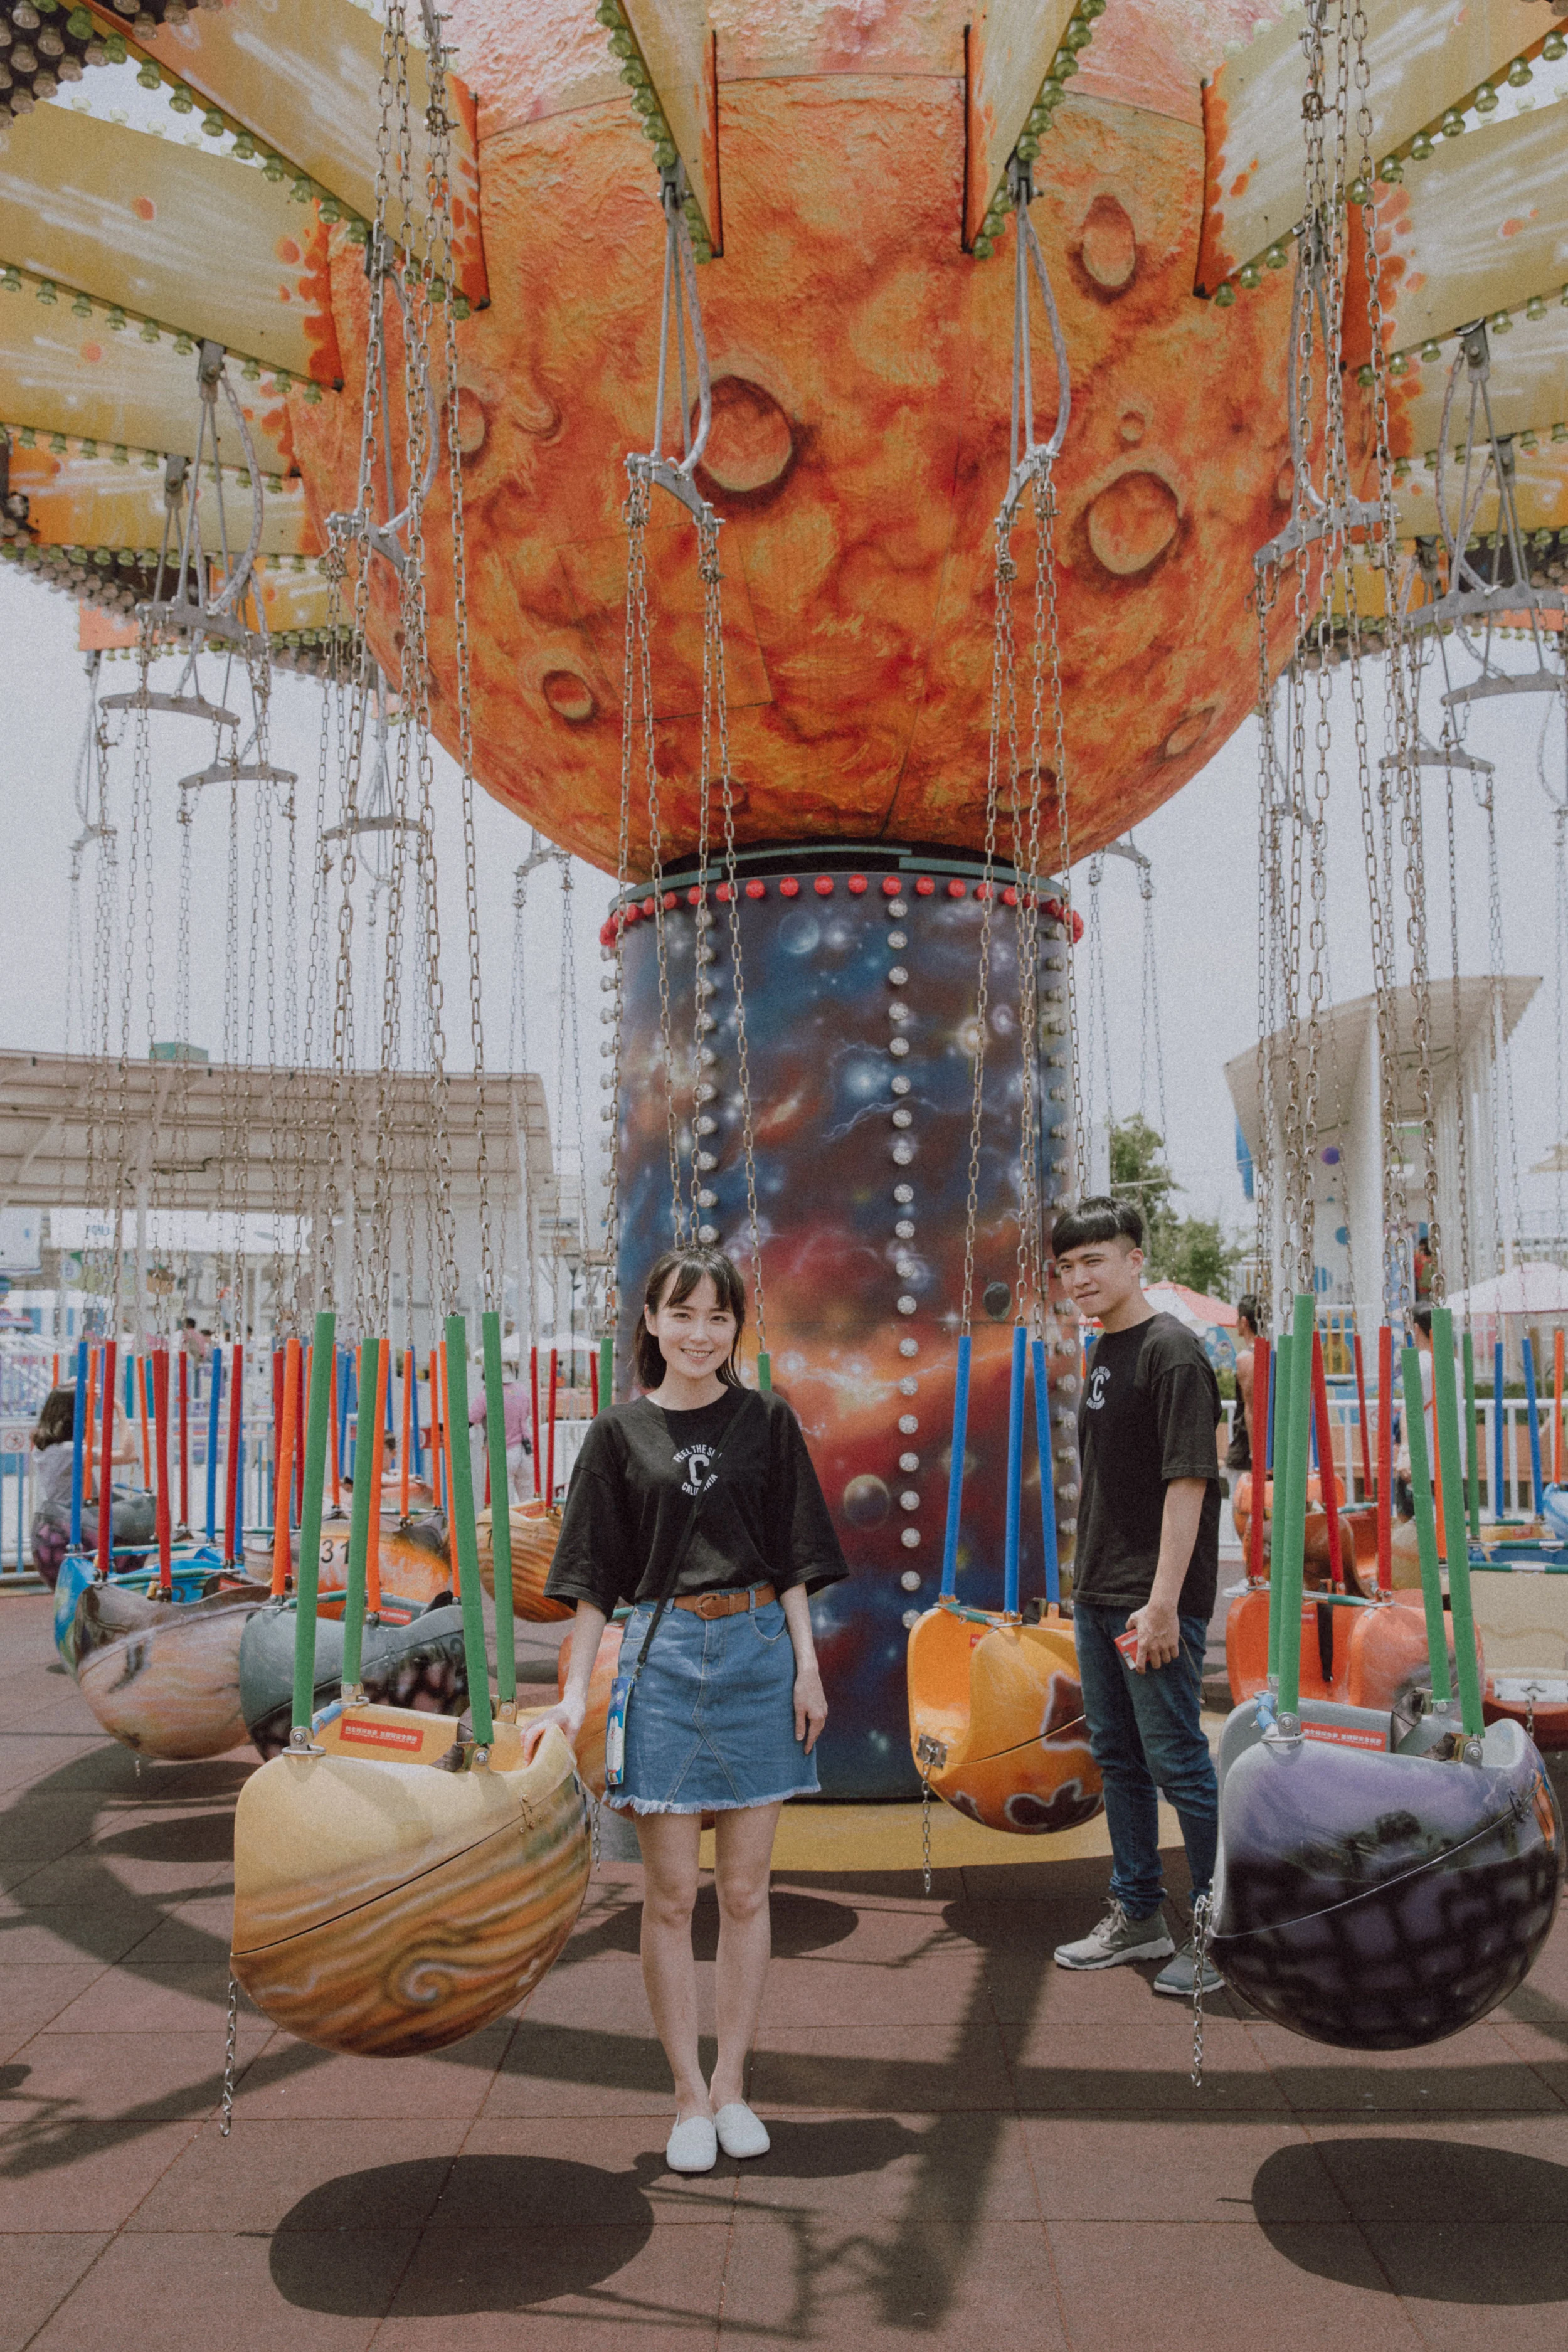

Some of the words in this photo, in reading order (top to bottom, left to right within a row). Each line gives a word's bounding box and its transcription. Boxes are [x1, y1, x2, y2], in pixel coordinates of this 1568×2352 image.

[1093, 1375, 1104, 1401] C
[672, 1448, 692, 1463] FEEL
[691, 1444, 707, 1453] THE
[689, 1454, 710, 1486] C
[320, 1539, 351, 1564] 31
